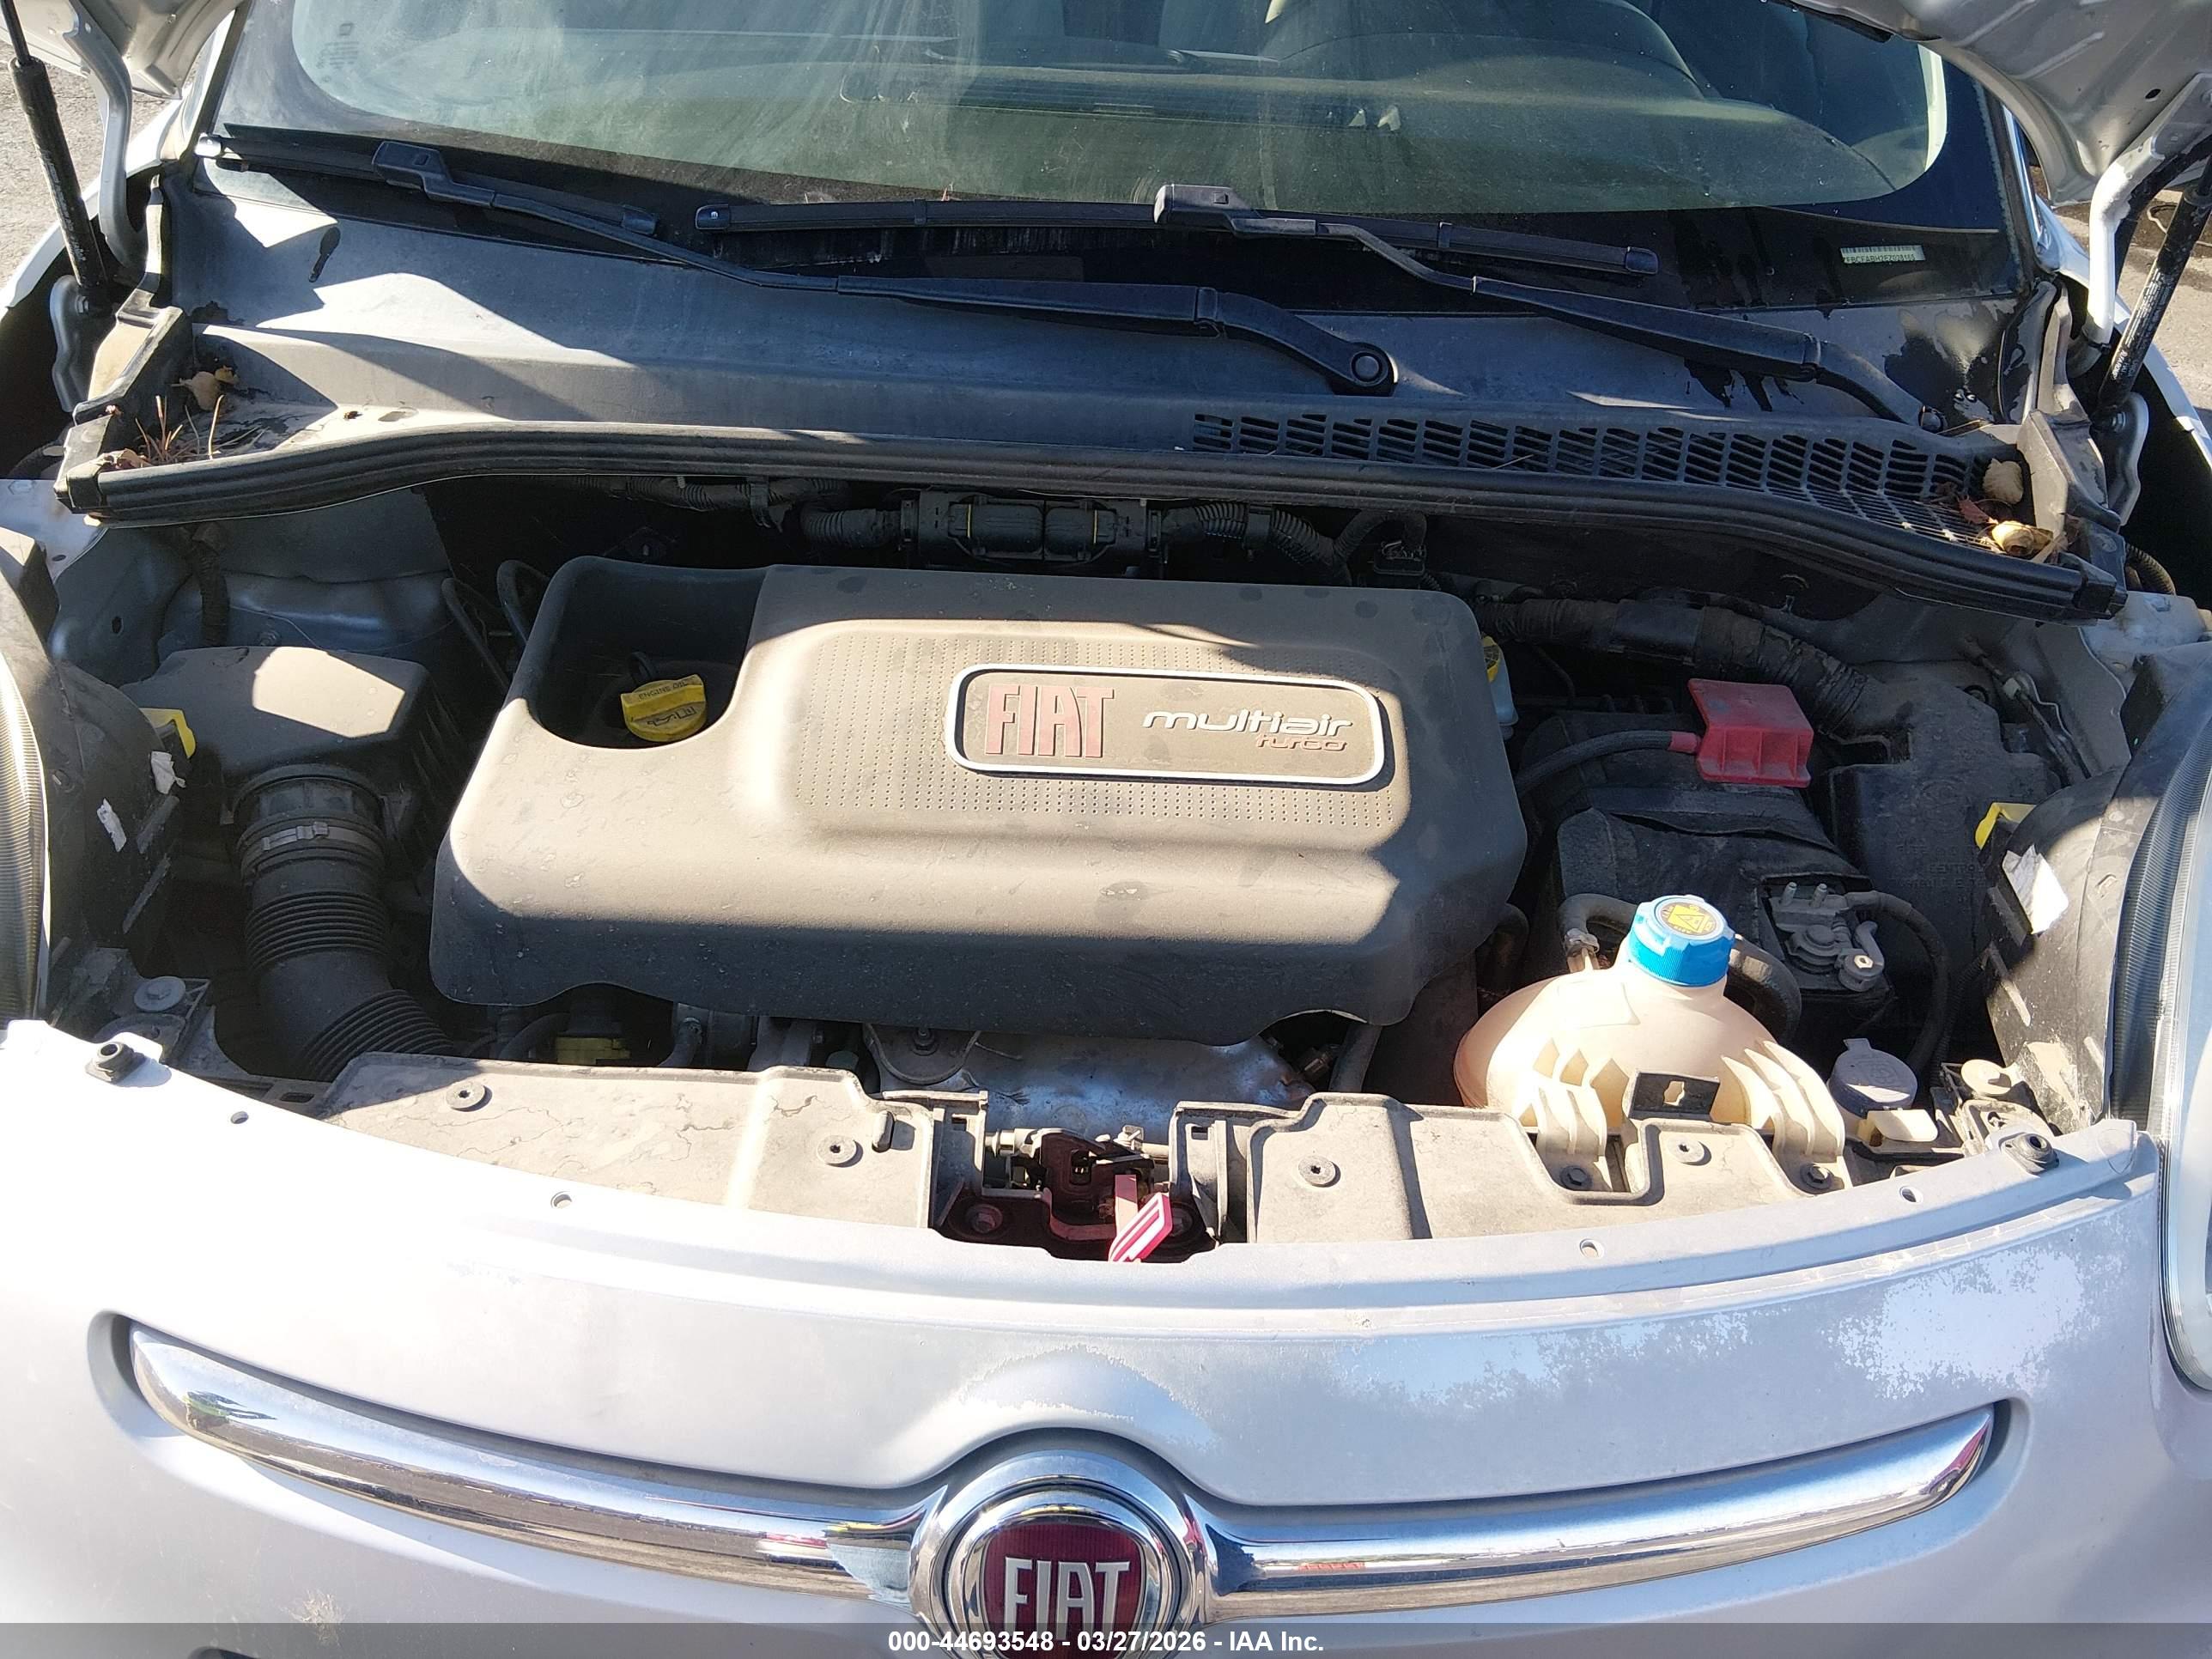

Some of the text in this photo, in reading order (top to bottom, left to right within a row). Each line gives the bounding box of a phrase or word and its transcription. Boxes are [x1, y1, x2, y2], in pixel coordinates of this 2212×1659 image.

[638, 685, 672, 700] ENGINE
[984, 684, 1115, 759] FIAT
[1142, 708, 1353, 736] multiair
[1255, 733, 1347, 751] turbo
[1004, 1557, 1131, 1640] FIAT
